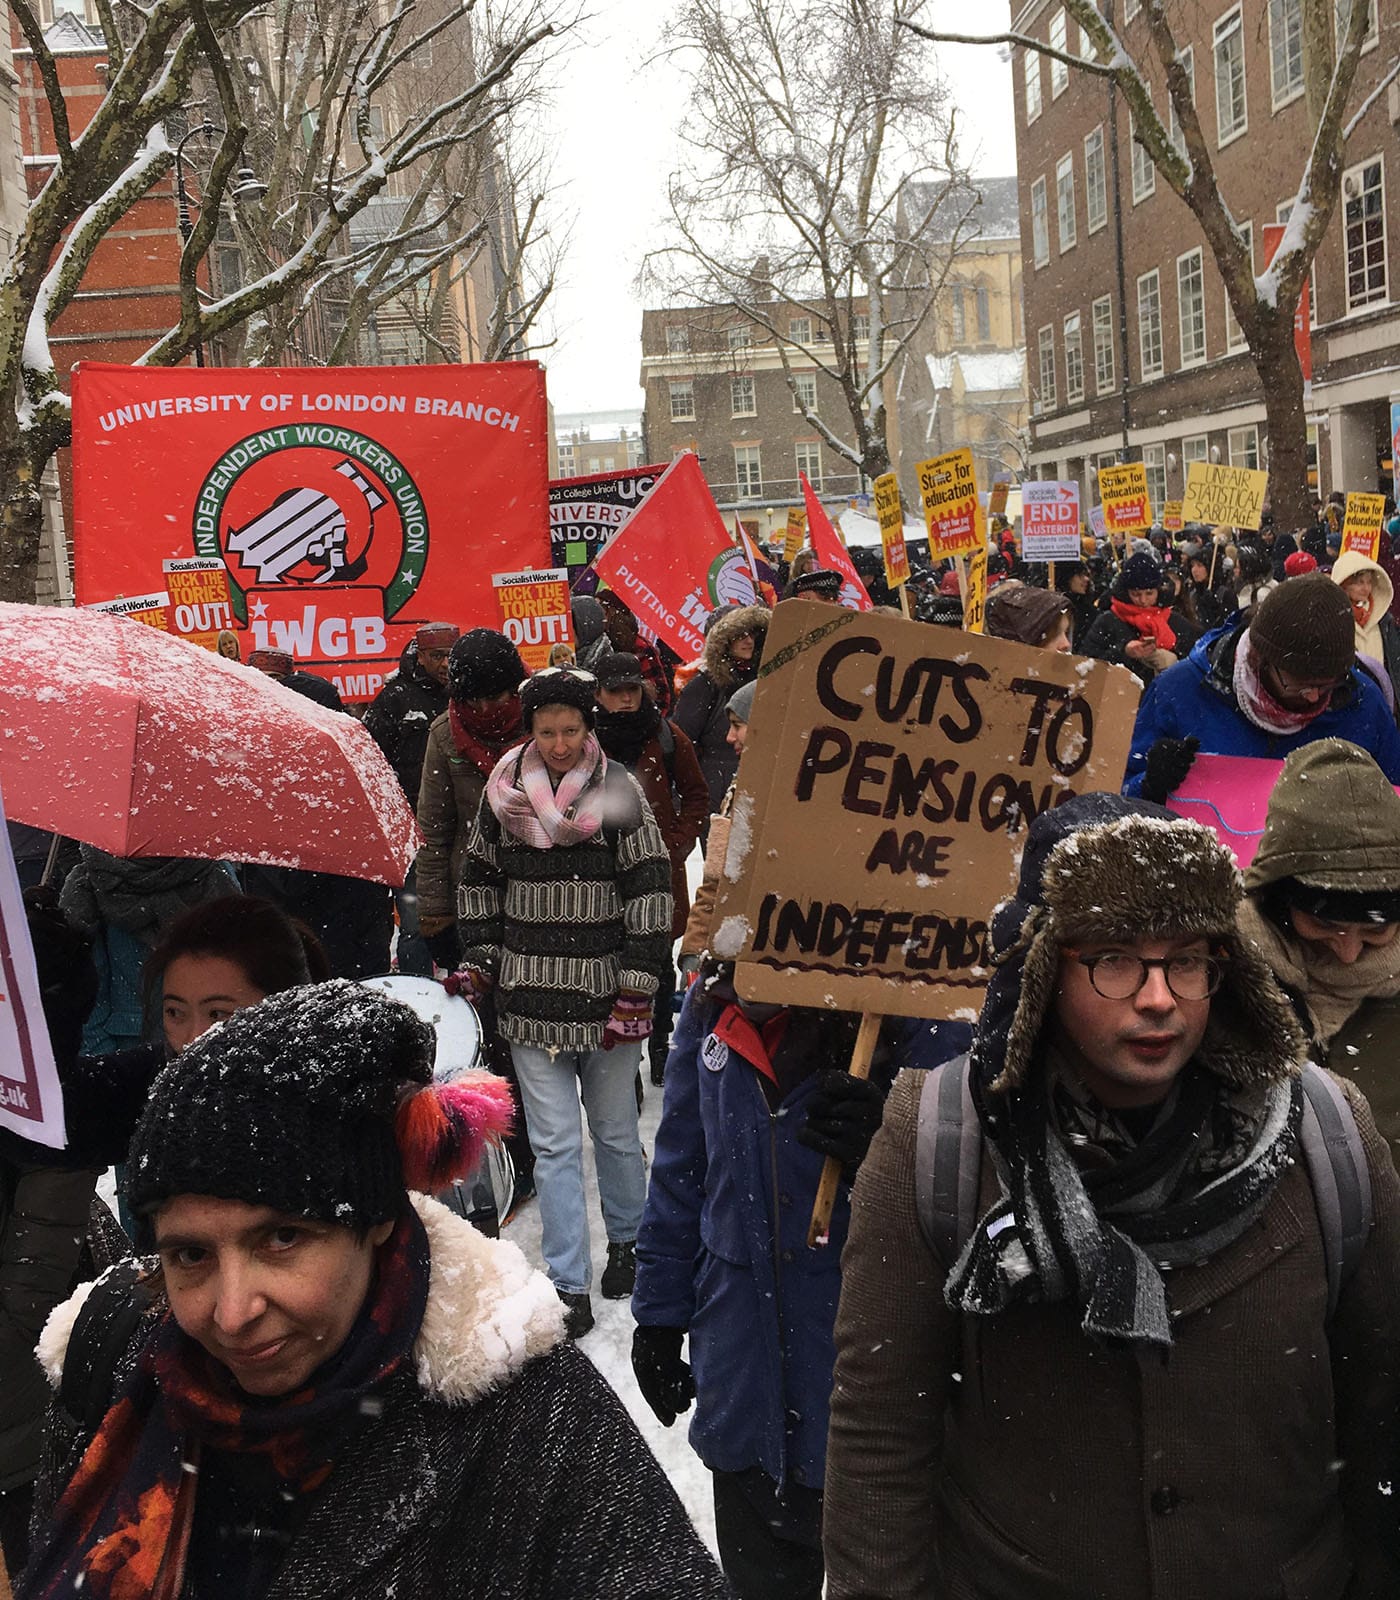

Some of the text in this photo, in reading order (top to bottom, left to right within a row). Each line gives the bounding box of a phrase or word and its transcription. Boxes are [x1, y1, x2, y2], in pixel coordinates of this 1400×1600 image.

[99, 394, 520, 432] UNIVERSITY OF LONDON BRANCH
[954, 462, 971, 481] for
[1101, 472, 1143, 489] Strike for
[1205, 466, 1251, 489] UNFAIR
[196, 426, 425, 554] INDEPENDENT WORKERS UNION
[563, 487, 592, 499] College
[593, 483, 617, 495] Union
[925, 481, 975, 509] education
[1103, 485, 1146, 500] education
[1187, 481, 1260, 513] STATISTICAL
[1031, 503, 1072, 522] END
[1193, 502, 1254, 527] SABOTAGE
[1348, 500, 1370, 514] Strike
[1026, 524, 1077, 535] AUSTERITY
[1346, 514, 1380, 527] education
[168, 571, 225, 588] KICK THE
[170, 586, 228, 606] TORIES
[497, 583, 564, 602] KICK THE
[615, 564, 678, 629] PUTTING
[175, 602, 233, 633] OUT!
[500, 596, 567, 619] TORIES
[502, 614, 569, 646] OUT!
[816, 636, 1094, 777] CUTS TO
[865, 828, 955, 877] ARE
